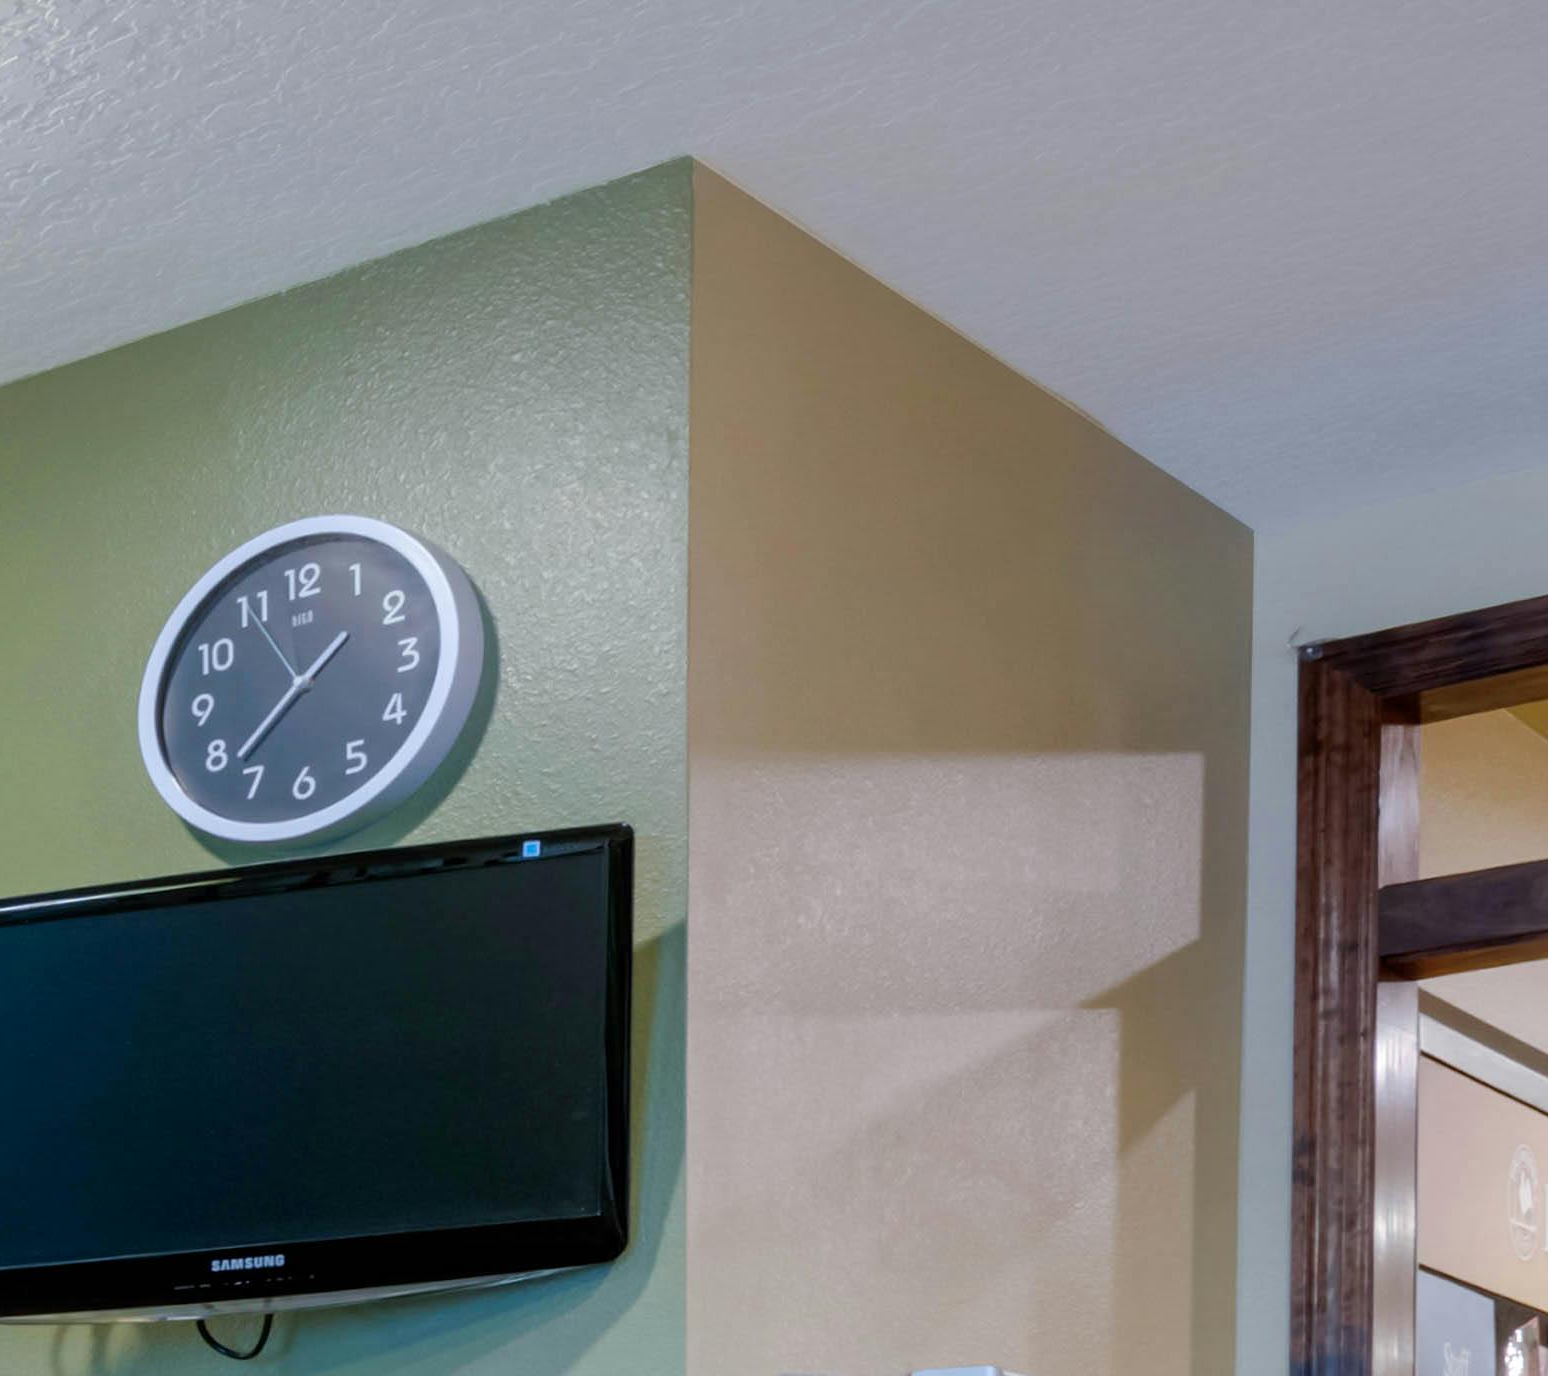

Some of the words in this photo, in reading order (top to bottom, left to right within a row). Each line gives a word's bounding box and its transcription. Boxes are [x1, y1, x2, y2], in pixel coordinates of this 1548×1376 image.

[284, 562, 322, 600] 12
[348, 563, 362, 596] 1
[236, 590, 269, 628] 11
[382, 590, 406, 624] 2
[198, 638, 234, 675] 10
[397, 636, 420, 673] 3
[191, 694, 214, 726] 9
[382, 692, 406, 724] 4
[205, 739, 228, 772] 8
[345, 740, 368, 775] 5
[242, 765, 265, 800] 7
[292, 766, 316, 800] 6
[211, 1254, 285, 1272] SAMSUNG
